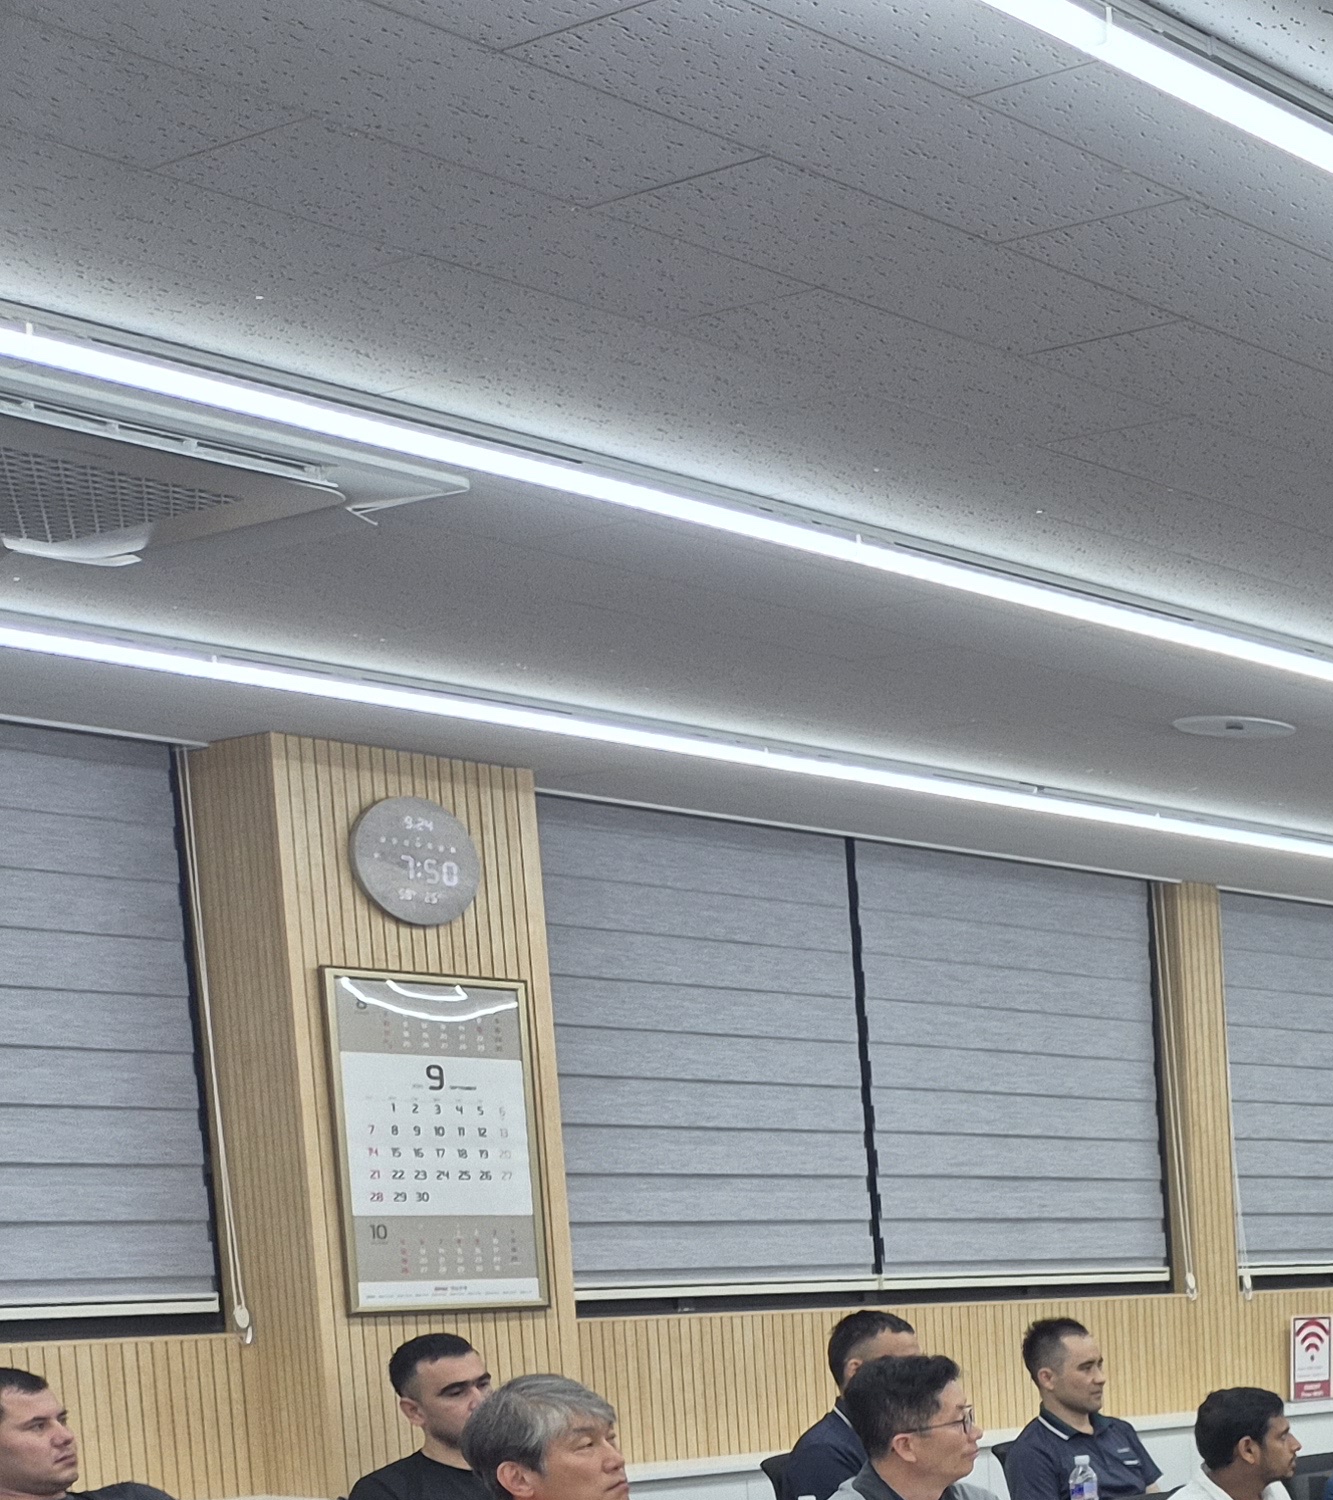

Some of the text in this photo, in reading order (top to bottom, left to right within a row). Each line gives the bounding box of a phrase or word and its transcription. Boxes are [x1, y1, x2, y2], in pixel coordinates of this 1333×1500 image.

[400, 854, 459, 887] 7:50
[425, 1064, 445, 1091] 9
[370, 1224, 388, 1240] 10
